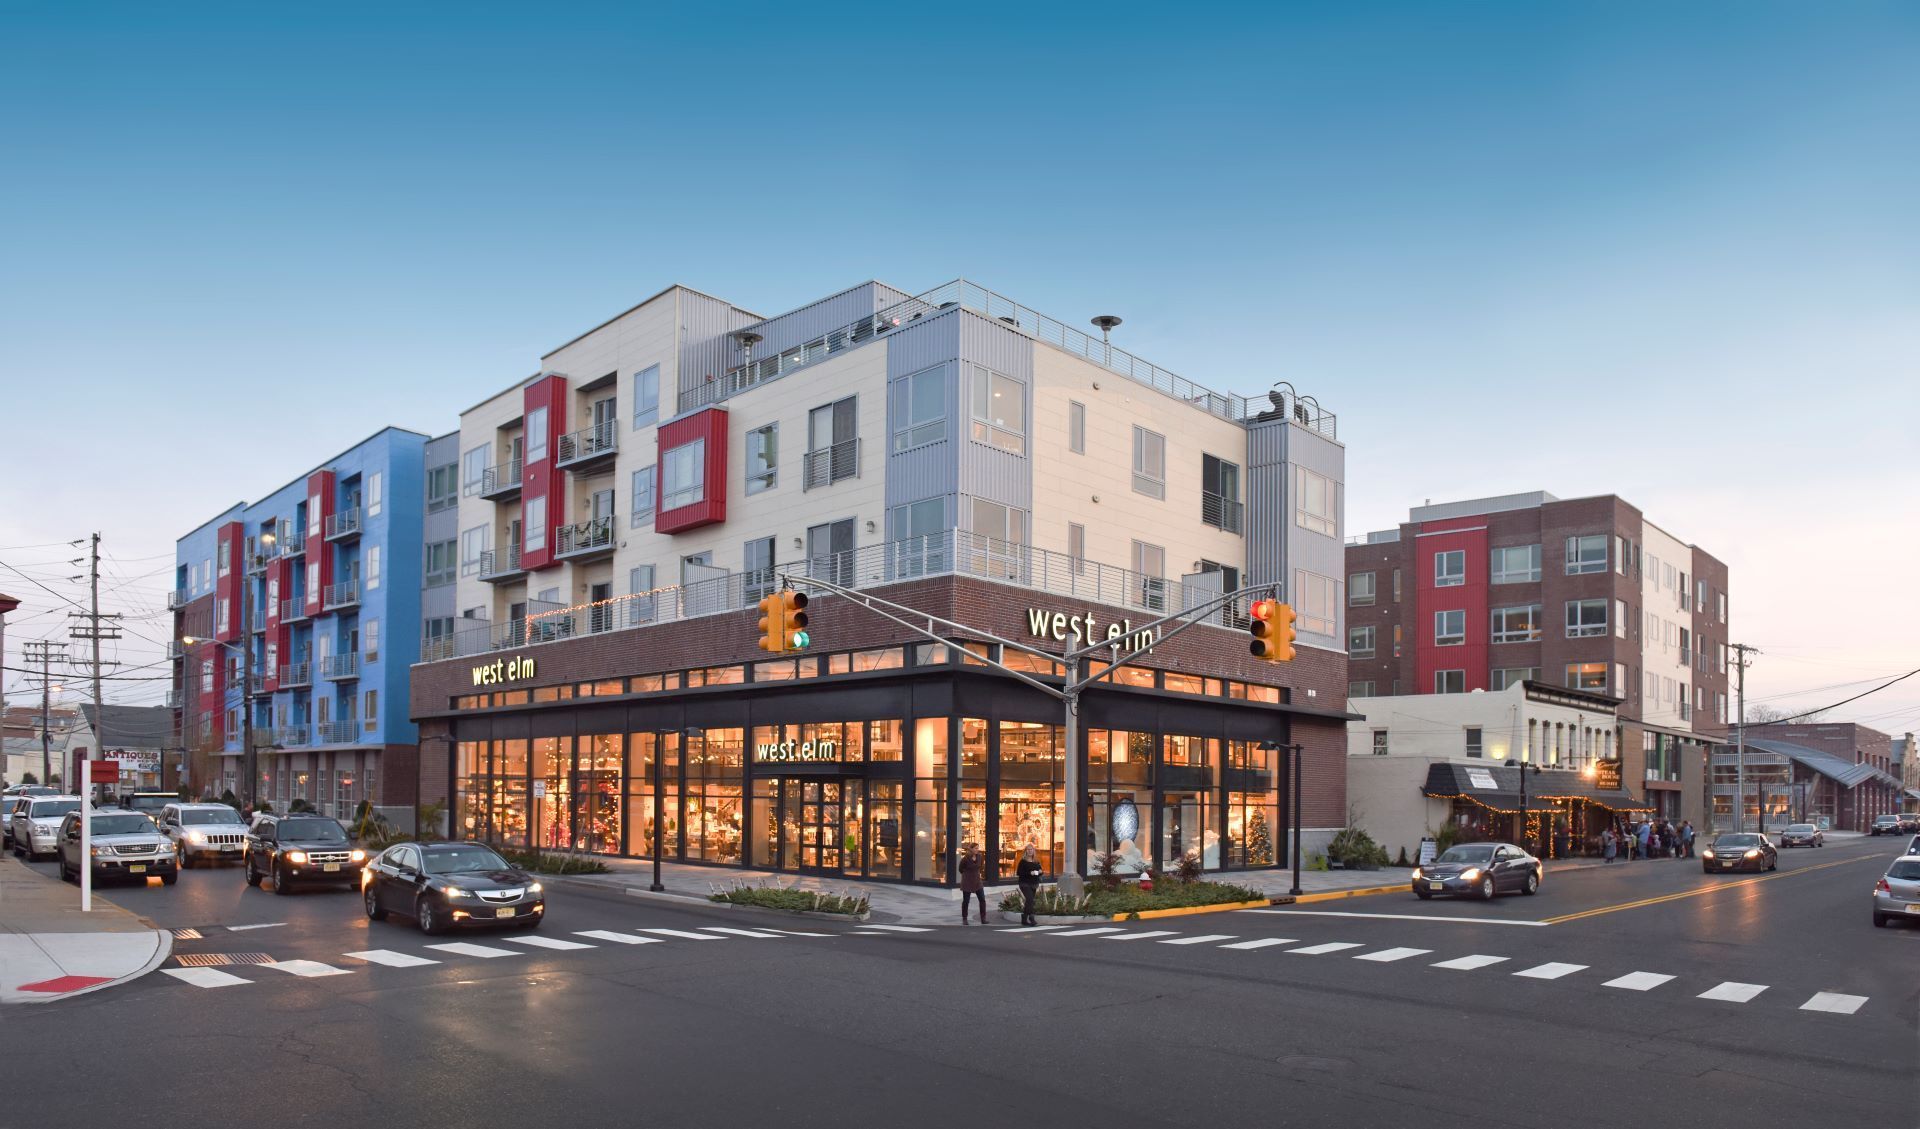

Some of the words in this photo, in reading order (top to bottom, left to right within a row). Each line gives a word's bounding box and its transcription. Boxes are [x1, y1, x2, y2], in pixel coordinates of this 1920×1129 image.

[1028, 608, 1095, 646] west
[1108, 619, 1153, 654] elm
[472, 658, 503, 686] west
[508, 655, 534, 681] elm
[104, 750, 158, 760] ANTIQUES
[757, 740, 795, 760] west
[802, 738, 833, 759] elm
